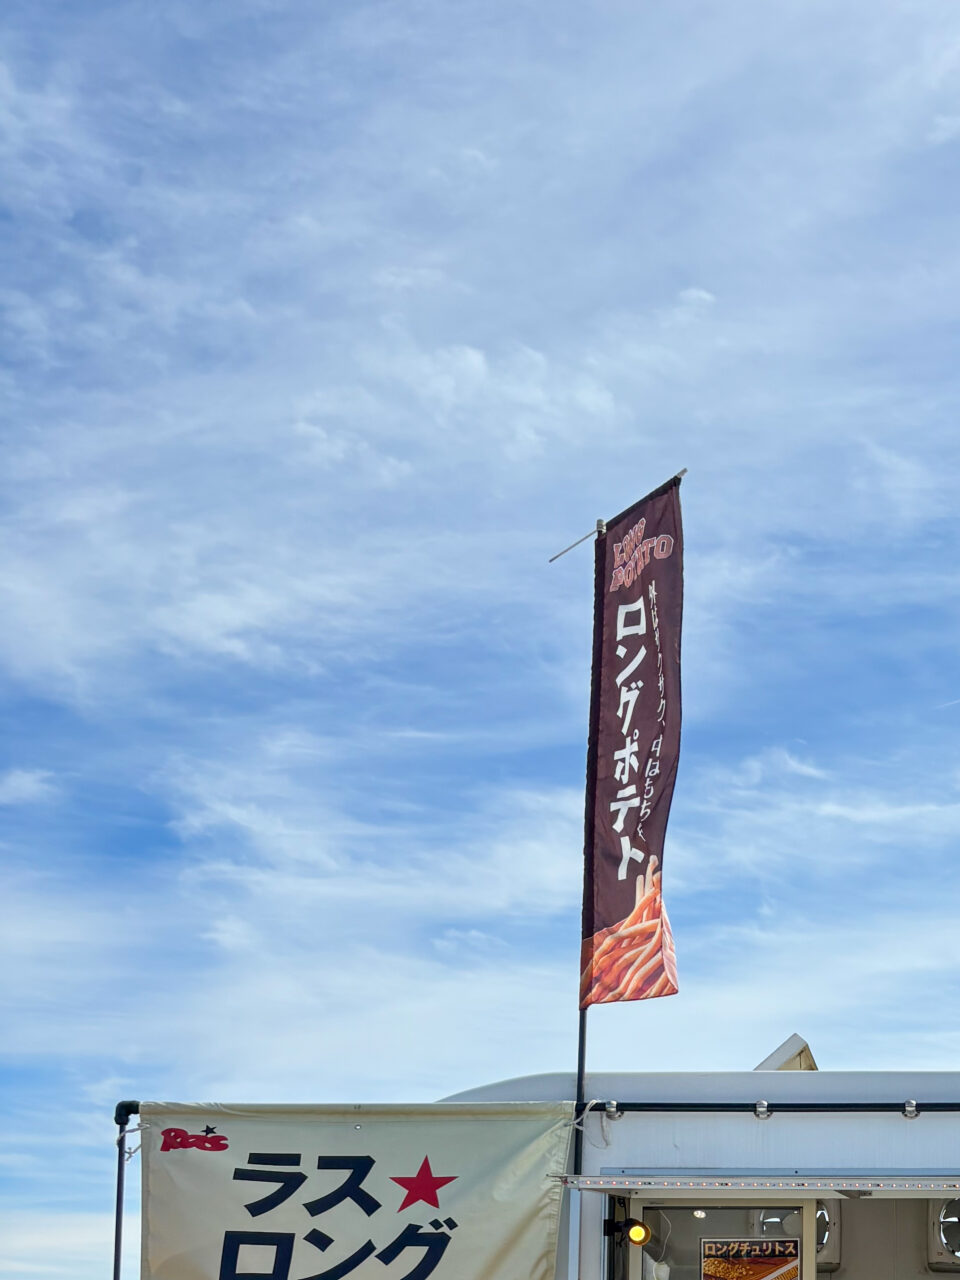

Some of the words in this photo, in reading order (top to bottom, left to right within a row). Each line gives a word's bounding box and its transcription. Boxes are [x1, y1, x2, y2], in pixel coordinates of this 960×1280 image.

[609, 595, 647, 881] ロングポテト
[232, 1152, 382, 1218] ラス
[704, 1242, 796, 1255] ロングチュリトス
